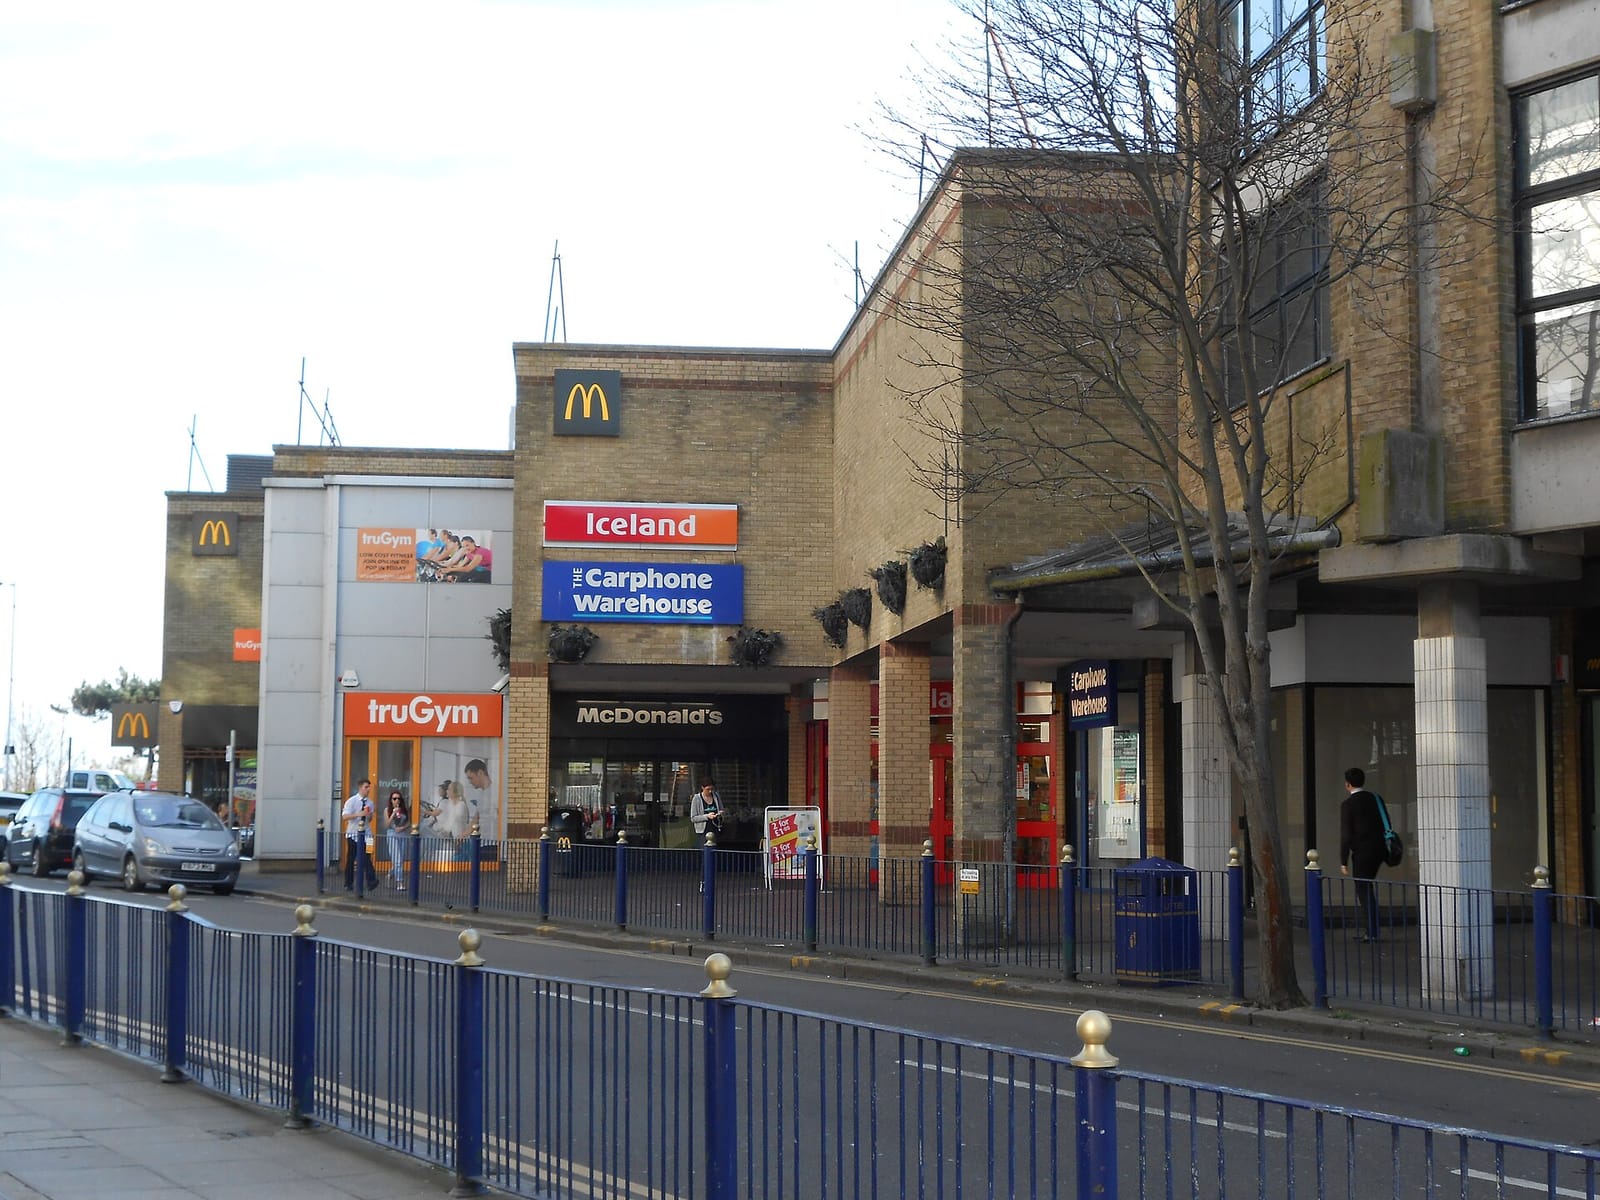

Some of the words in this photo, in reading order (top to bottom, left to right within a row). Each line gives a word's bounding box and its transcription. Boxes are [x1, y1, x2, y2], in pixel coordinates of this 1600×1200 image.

[586, 513, 696, 537] Iceland
[362, 532, 412, 549] truGym
[572, 567, 583, 589] THE
[585, 568, 713, 592] Carphone
[573, 594, 713, 614] Warehouse
[1074, 667, 1107, 694] Carphone
[368, 695, 479, 733] truGym
[576, 707, 723, 725] McDonald's
[1071, 695, 1107, 717] Warehouse
[379, 779, 410, 790] truGym
[779, 819, 789, 827] for
[780, 843, 791, 851] for
